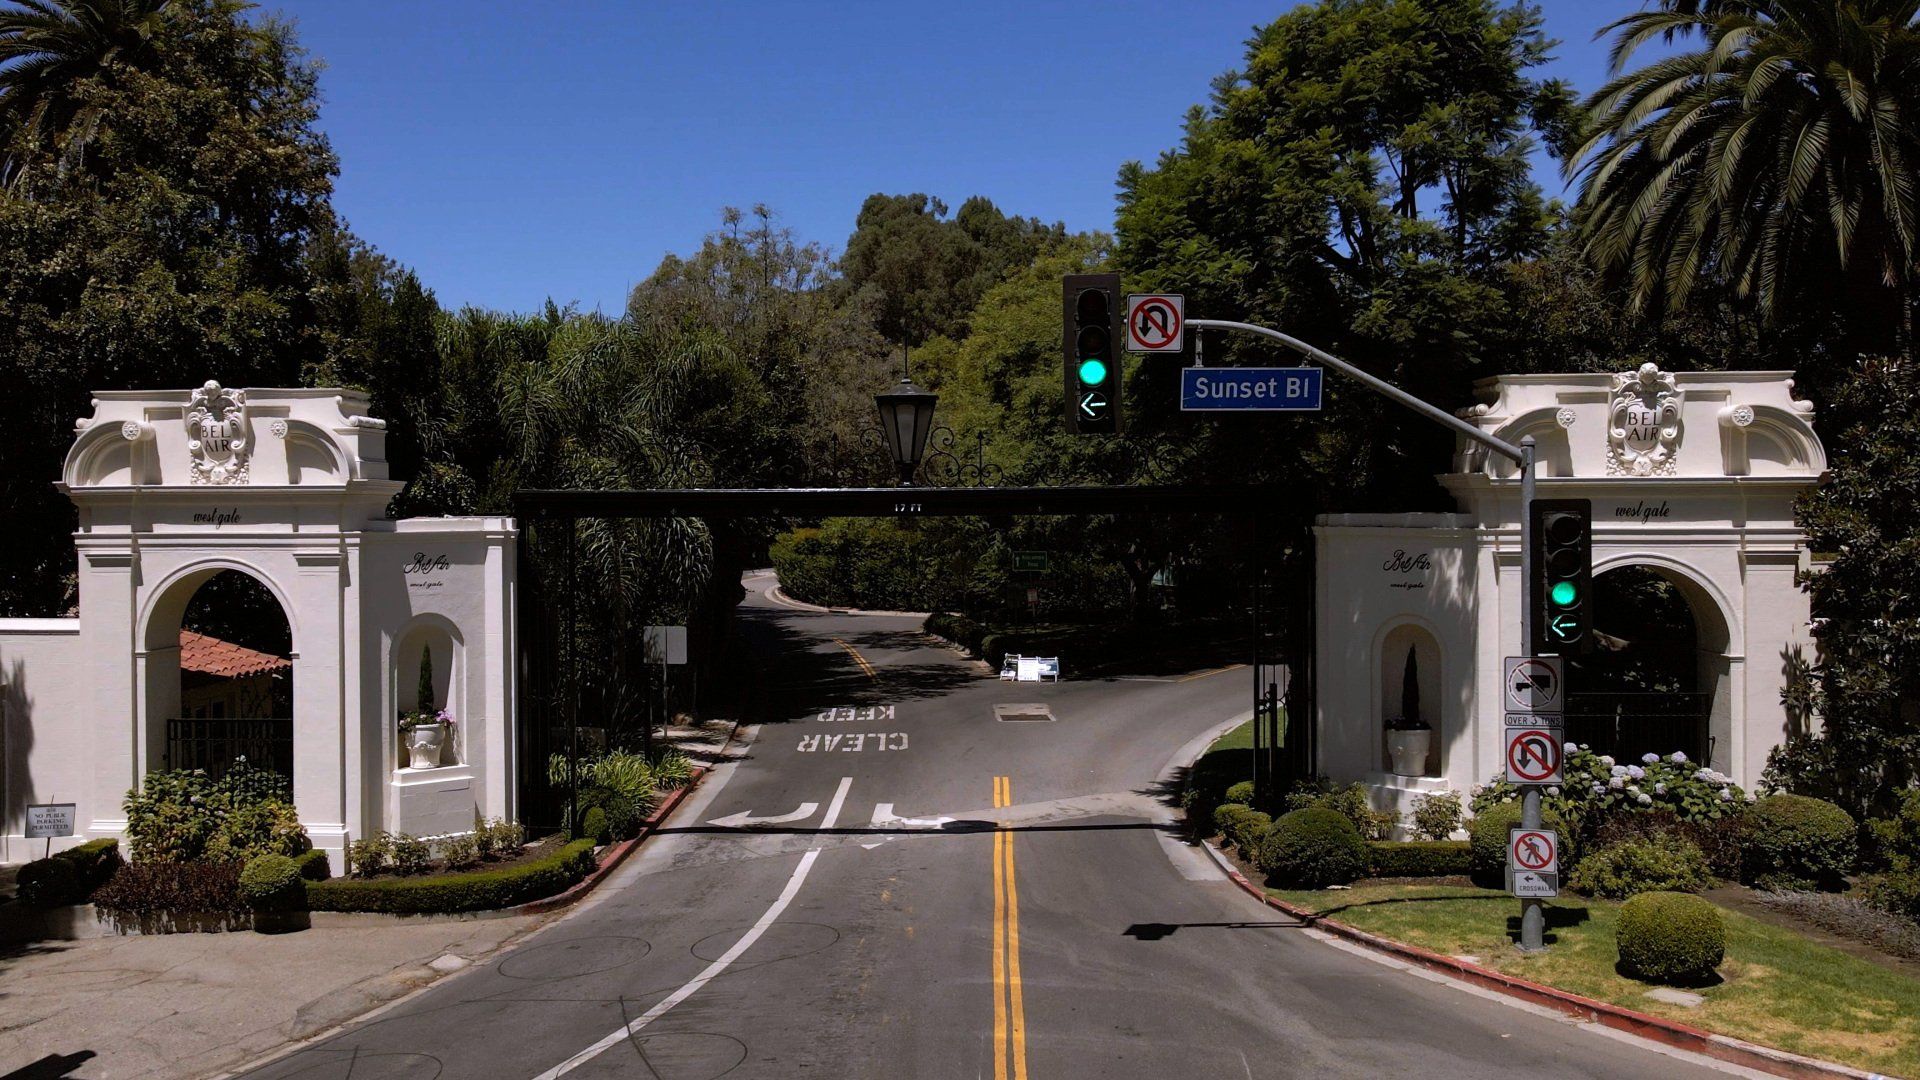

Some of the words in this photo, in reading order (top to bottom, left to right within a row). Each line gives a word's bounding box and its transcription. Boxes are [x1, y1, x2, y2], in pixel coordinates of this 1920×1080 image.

[1194, 376, 1278, 399] Sunset
[1286, 377, 1309, 398] Bl
[1627, 411, 1661, 426] BEL
[201, 425, 231, 438] BEL
[1627, 427, 1660, 441] AIR
[205, 439, 232, 452] AIR
[193, 507, 218, 523] west
[216, 507, 242, 530] gate
[1615, 500, 1643, 517] west
[1641, 500, 1670, 524] gate
[816, 705, 895, 722] KEEP
[1507, 716, 1528, 725] OVER
[1541, 716, 1561, 726] TONS
[796, 732, 909, 752] CLEAR
